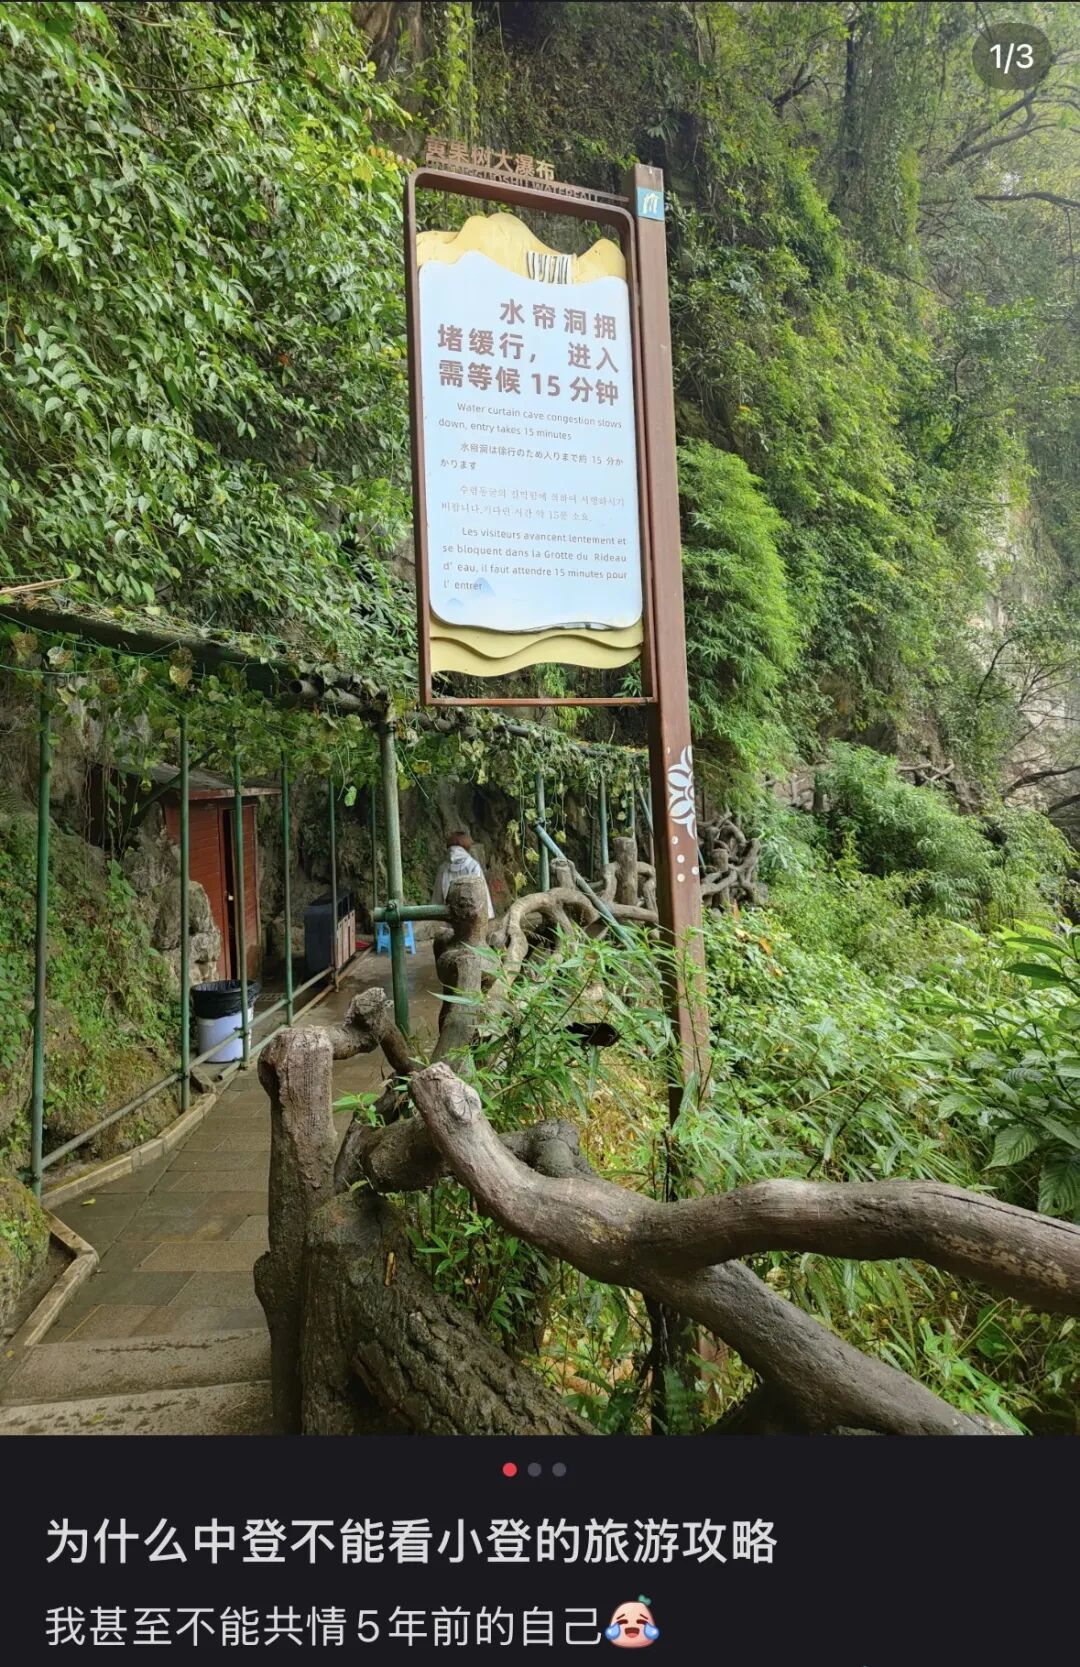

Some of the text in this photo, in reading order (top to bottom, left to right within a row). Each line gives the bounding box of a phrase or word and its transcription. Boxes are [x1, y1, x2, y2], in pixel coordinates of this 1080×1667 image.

[499, 298, 617, 341] 水帘洞拥
[438, 359, 619, 406] 需等候 15 分钟
[457, 402, 622, 429] Water curtain cave congestion slows
[438, 418, 572, 441] down, entry takes 15 minutes
[440, 458, 477, 471] かります
[462, 526, 627, 546] Les visiteurs avancent lentement et
[443, 543, 627, 563] se bloquent dans la Grotte du Rideau
[481, 562, 488, 573] il
[490, 563, 510, 574] faut
[512, 565, 552, 576] attendre
[554, 567, 566, 577] 15
[568, 567, 604, 579] minutes
[606, 570, 628, 581] pour
[454, 580, 483, 591] entrer
